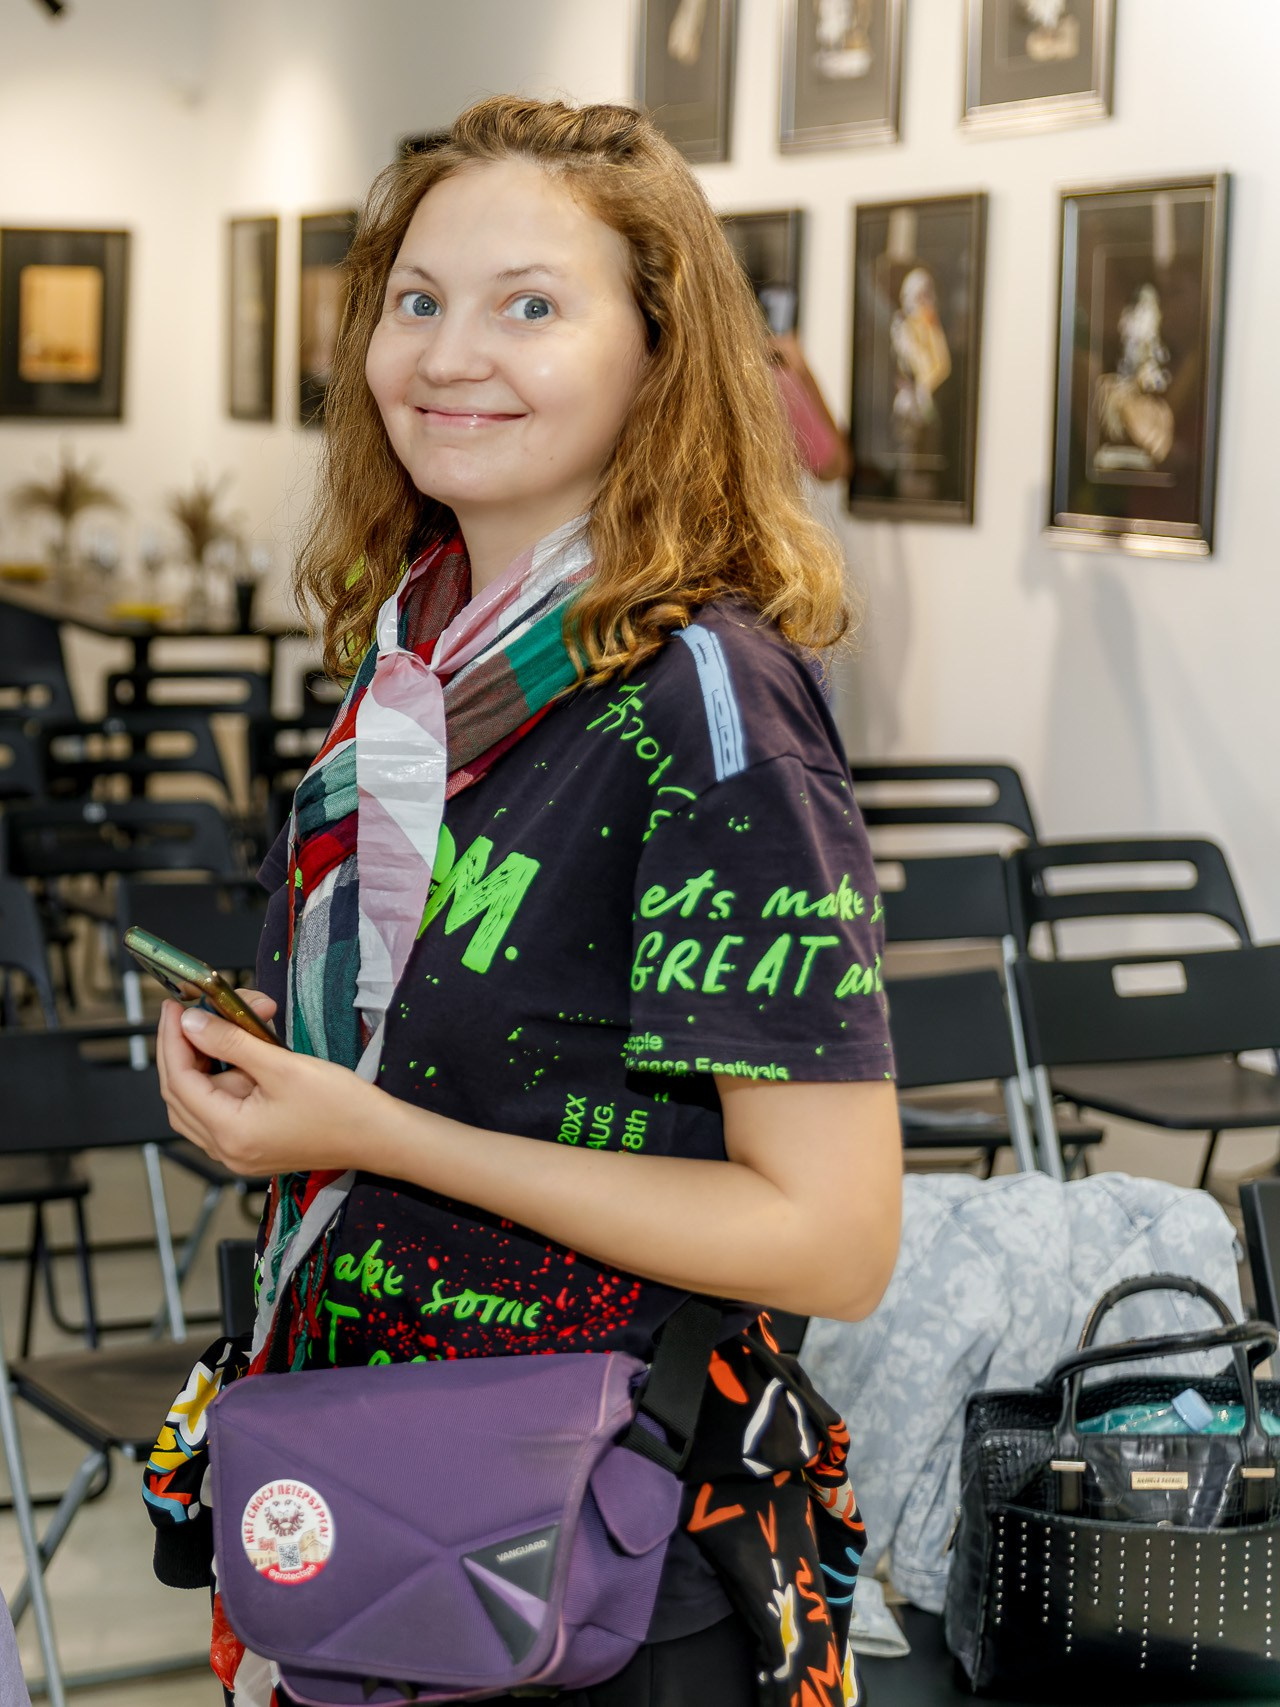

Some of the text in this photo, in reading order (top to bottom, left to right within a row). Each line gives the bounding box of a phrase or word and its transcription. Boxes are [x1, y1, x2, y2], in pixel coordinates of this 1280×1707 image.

[761, 872, 864, 921] make
[631, 931, 840, 997] GREAT
[557, 1092, 588, 1146] 20XX
[621, 1109, 650, 1150] 8th
[333, 1239, 542, 1329] ake some
[246, 1485, 275, 1519] СНОСУ
[244, 1521, 256, 1545] НЕТ
[495, 1539, 549, 1564] VANGUARD
